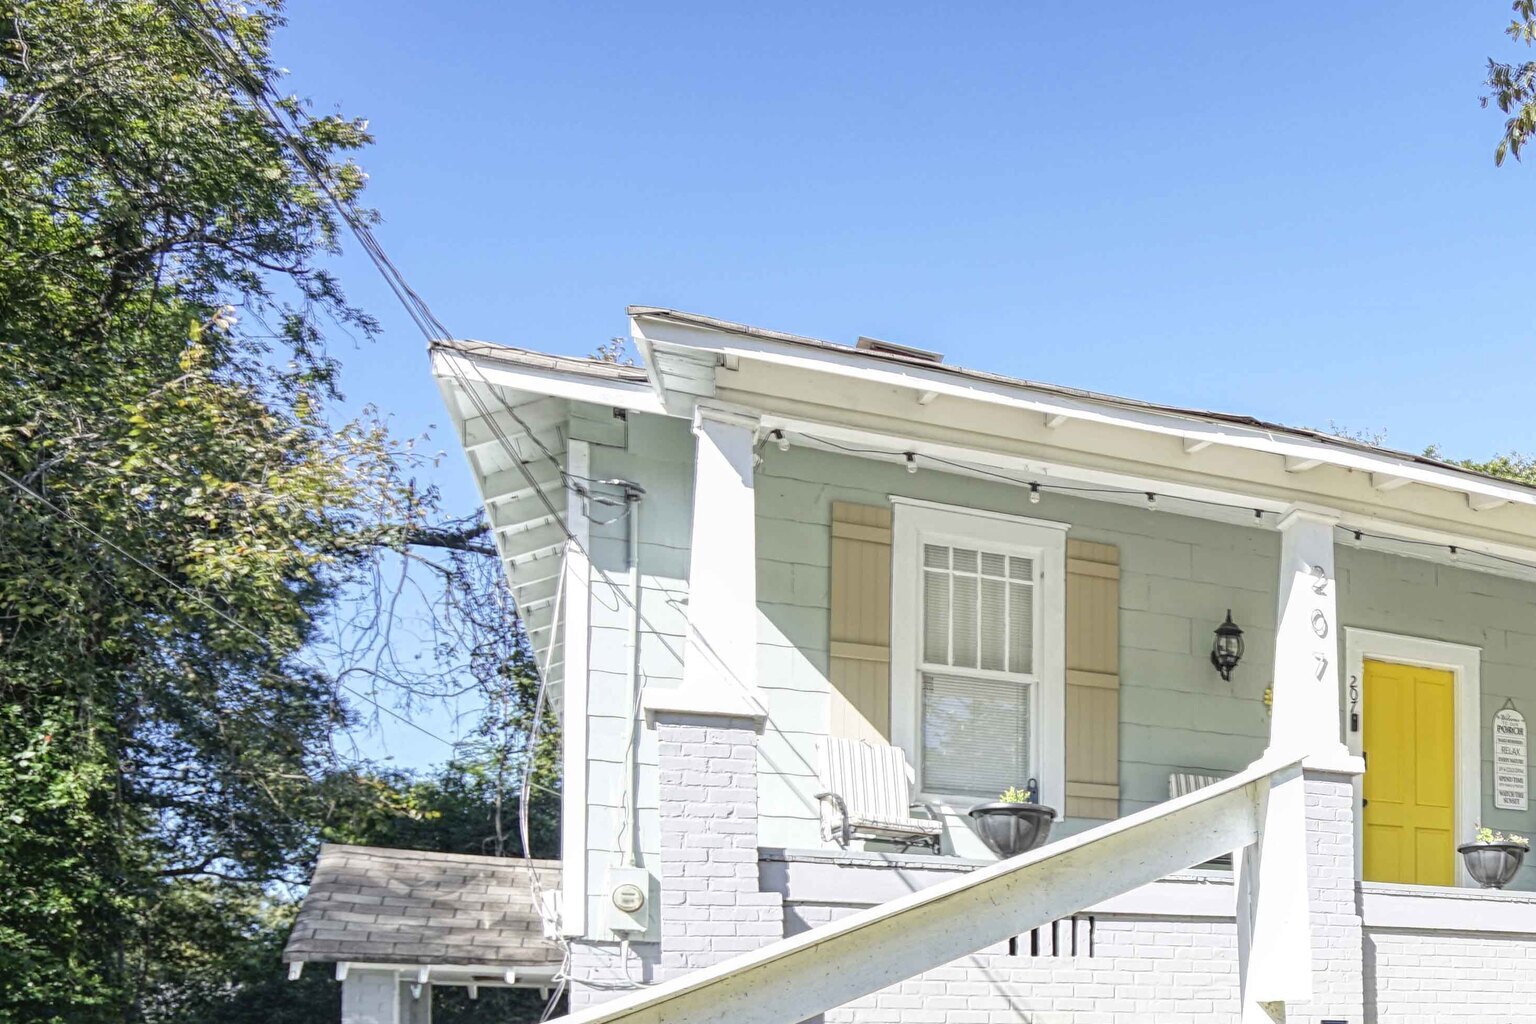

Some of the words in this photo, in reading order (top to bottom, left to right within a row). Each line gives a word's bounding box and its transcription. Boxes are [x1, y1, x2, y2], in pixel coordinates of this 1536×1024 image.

[1311, 565, 1328, 682] 207
[1350, 675, 1358, 713] 207
[1497, 725, 1524, 735] PORCH
[1501, 746, 1520, 756] RELAX
